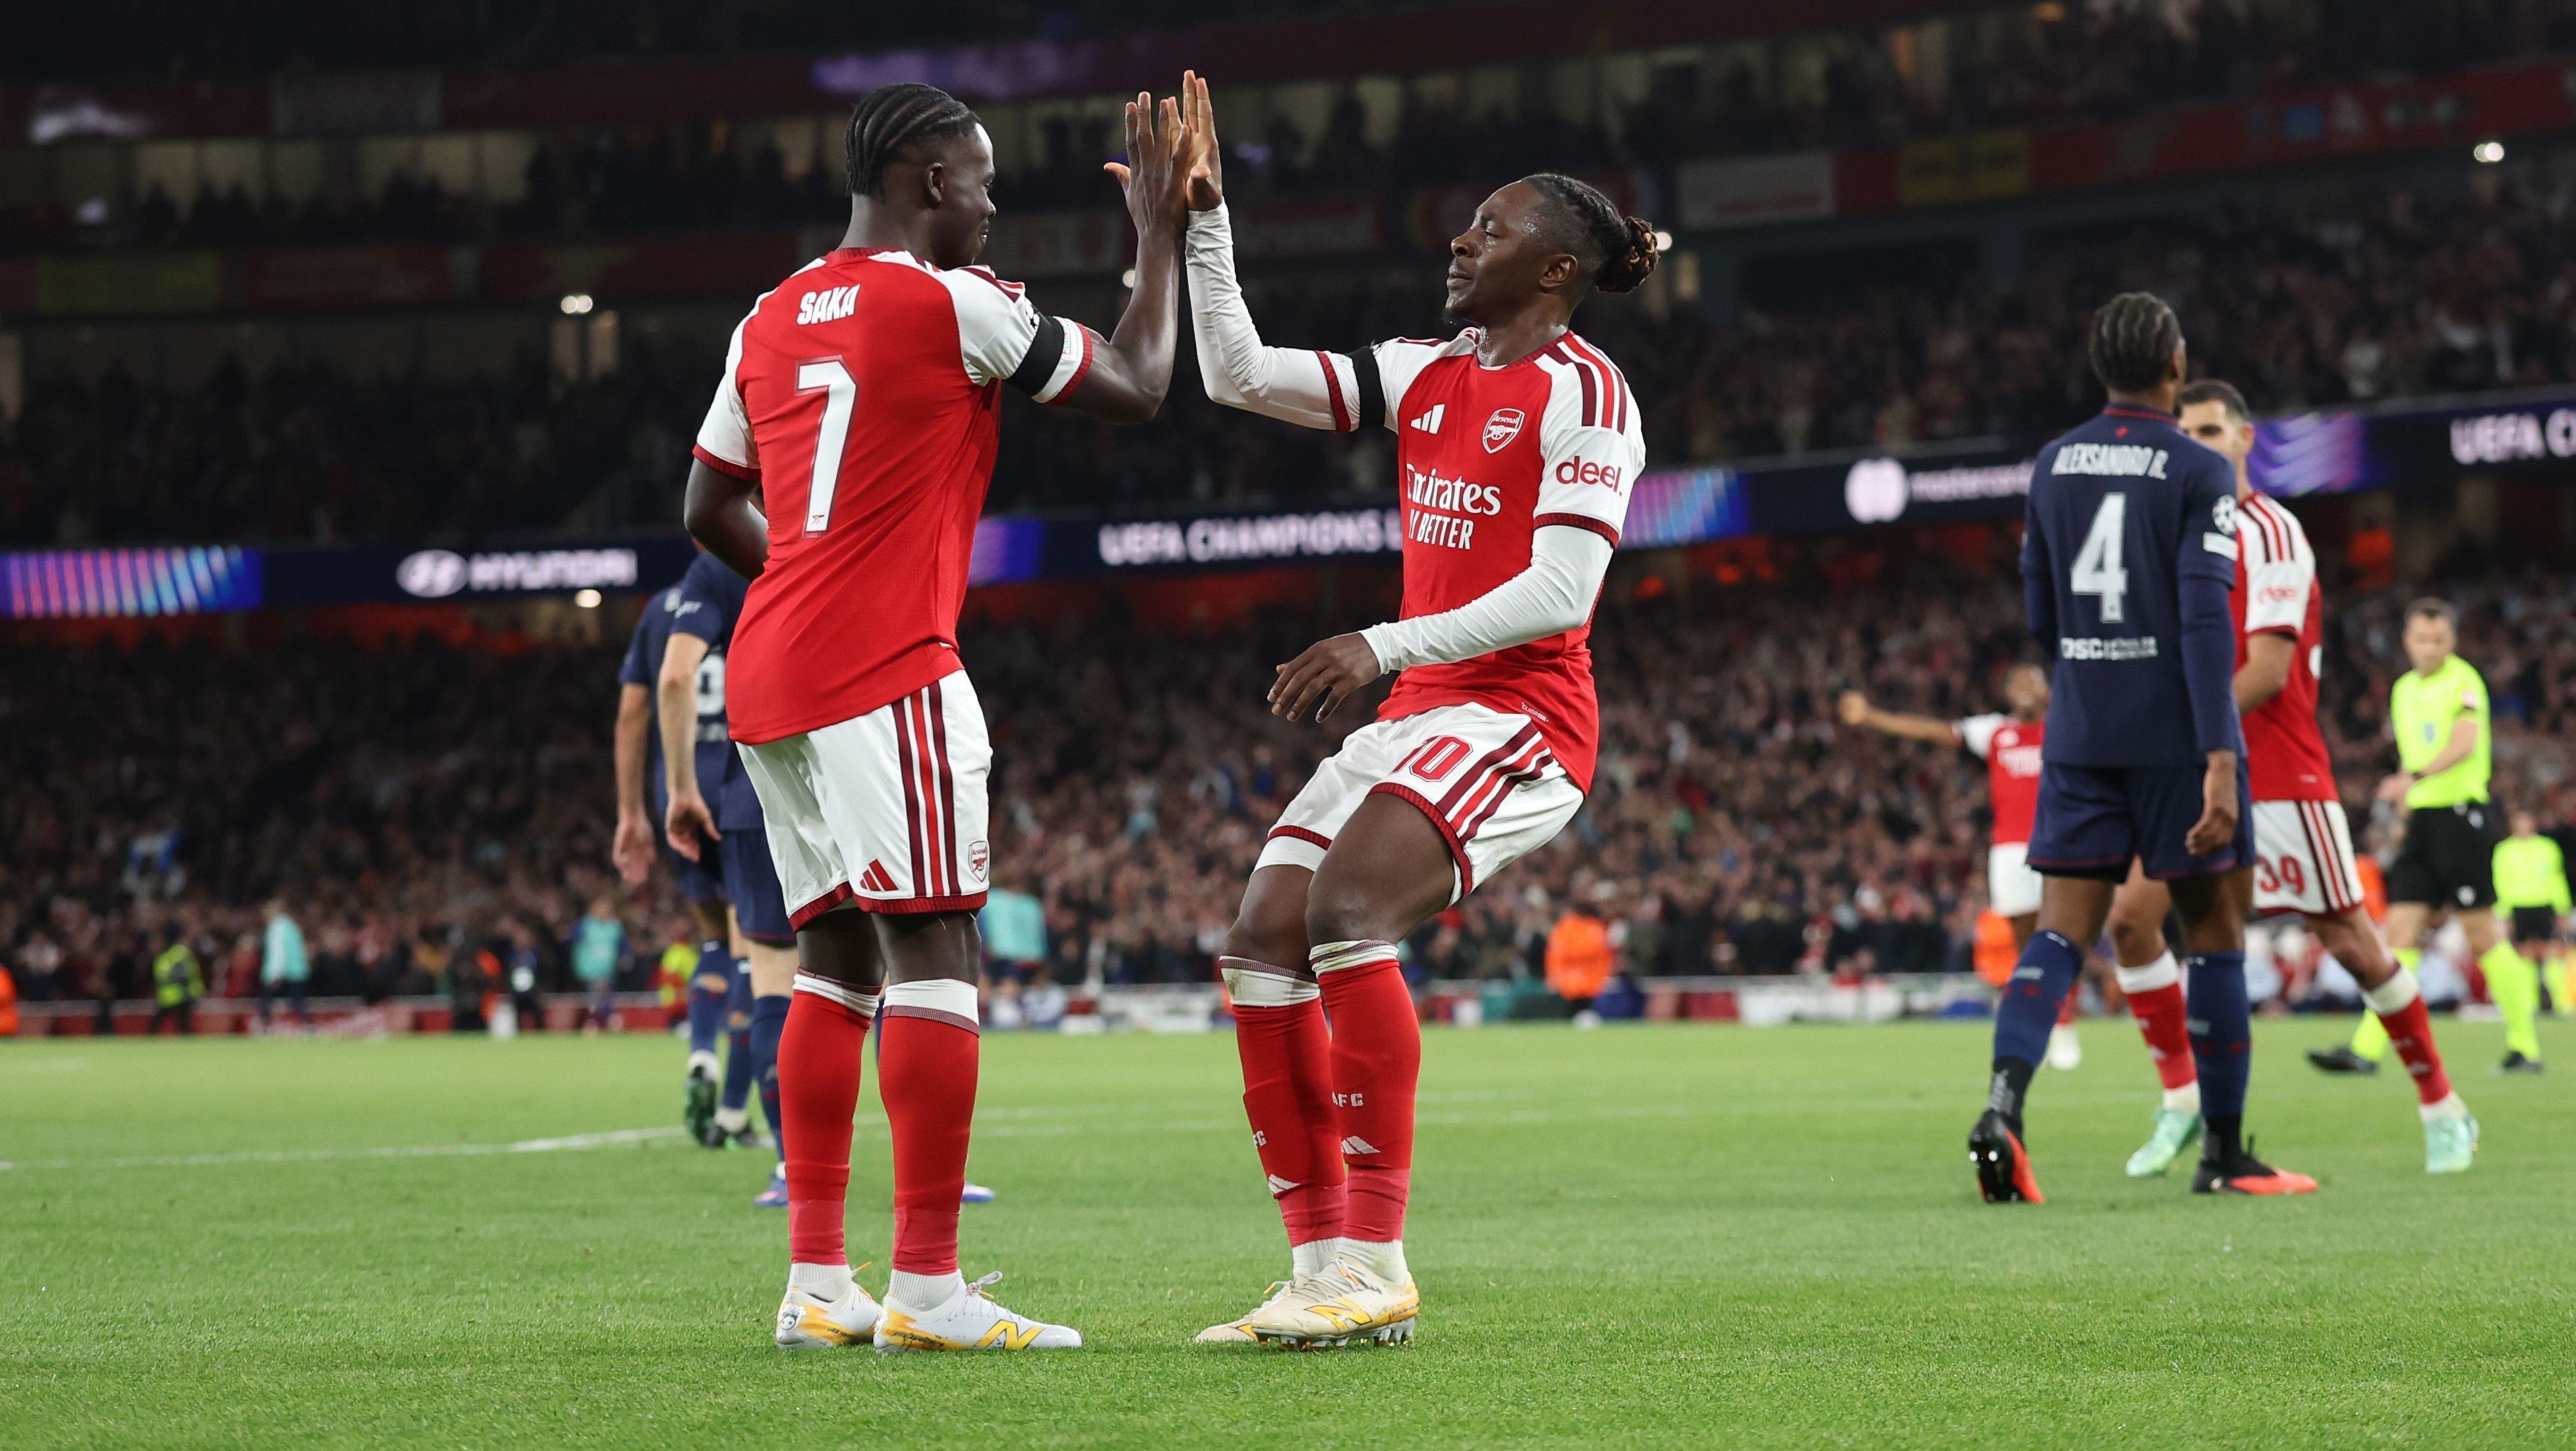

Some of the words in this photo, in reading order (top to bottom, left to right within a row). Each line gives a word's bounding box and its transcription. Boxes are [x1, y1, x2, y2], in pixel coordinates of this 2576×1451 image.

[796, 284, 860, 325] SAKA
[1493, 414, 1519, 424] Arsenal
[796, 357, 858, 536] 7
[1416, 512, 1474, 550] BETTER
[2070, 491, 2128, 623] 4
[1391, 734, 1474, 782] 10
[1332, 1092, 1364, 1107] AFC
